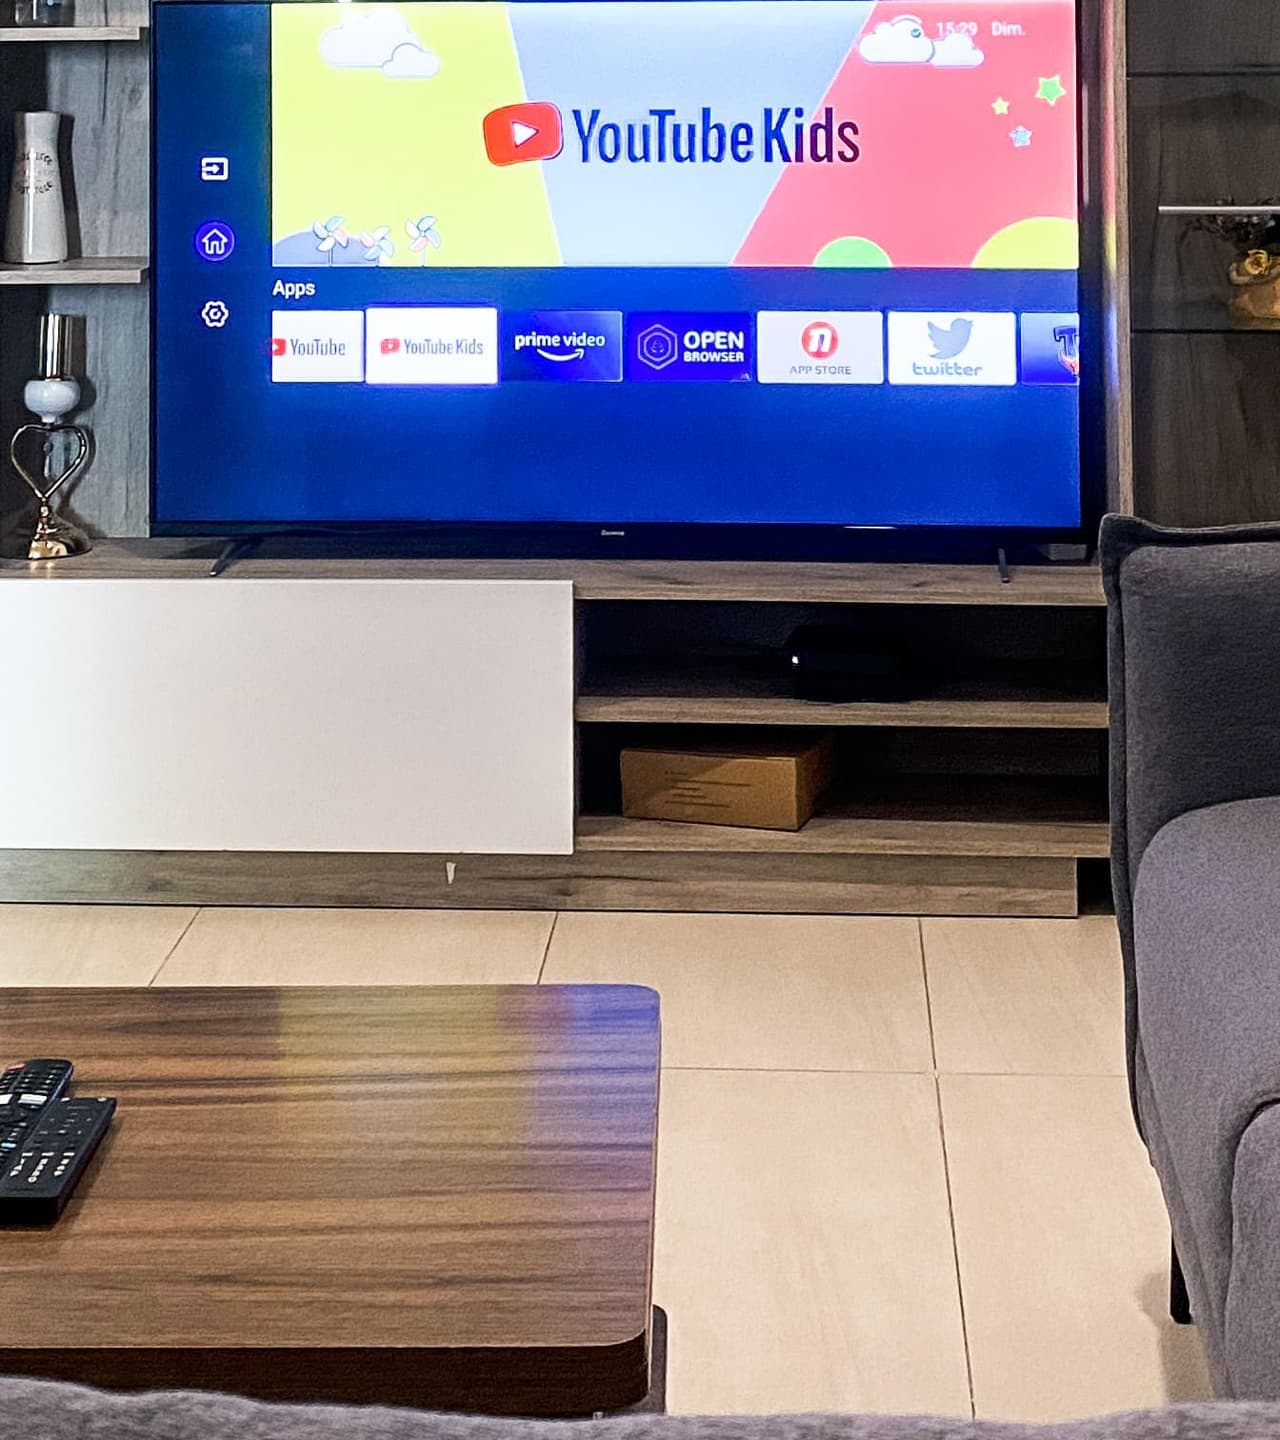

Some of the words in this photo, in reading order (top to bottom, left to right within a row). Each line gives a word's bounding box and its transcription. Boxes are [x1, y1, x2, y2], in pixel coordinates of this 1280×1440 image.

[991, 21, 1027, 37] Dim.
[572, 106, 754, 164] YouTube
[763, 106, 860, 164] Kids
[272, 280, 316, 299] Apps
[290, 338, 346, 357] YouTube
[404, 338, 454, 356] YouTube
[456, 338, 484, 356] Kids
[514, 332, 561, 351] prime
[563, 332, 606, 348] video
[683, 331, 745, 350] OPEN
[683, 351, 745, 363] BROWSER
[789, 365, 812, 376] APP
[814, 365, 852, 376] STORE
[912, 361, 983, 377] twitter
